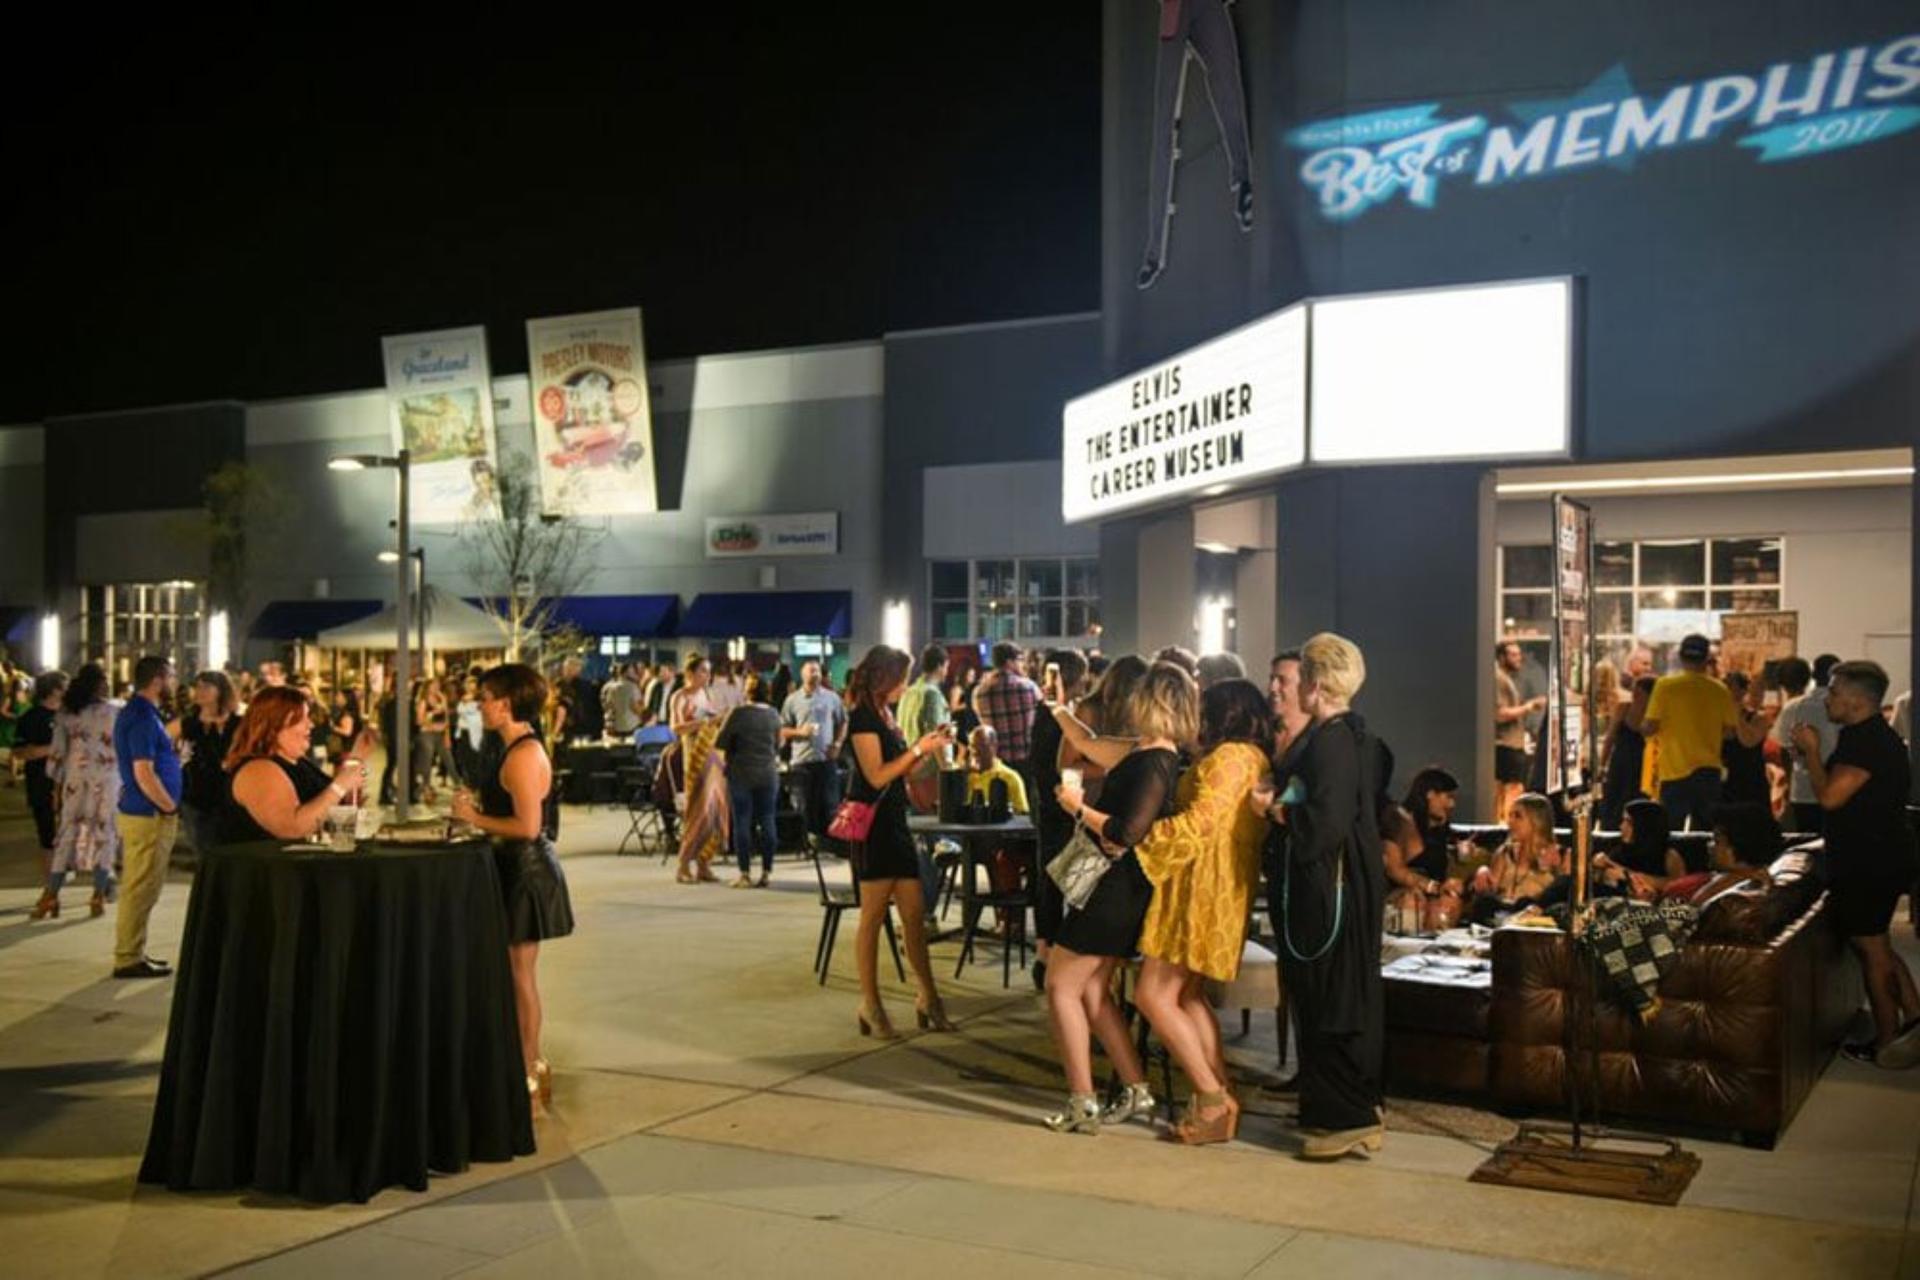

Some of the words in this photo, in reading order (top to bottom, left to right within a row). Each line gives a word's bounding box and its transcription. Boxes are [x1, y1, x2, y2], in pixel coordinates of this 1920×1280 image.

[1475, 34, 1920, 186] MEMPHIS
[1788, 107, 1892, 152] 2017
[1087, 431, 1113, 464] THE
[1119, 382, 1253, 454] ENTERTAINER
[1132, 365, 1182, 410] ELVIS
[1091, 456, 1156, 500] CAREER
[1164, 429, 1244, 482] MUSEUM
